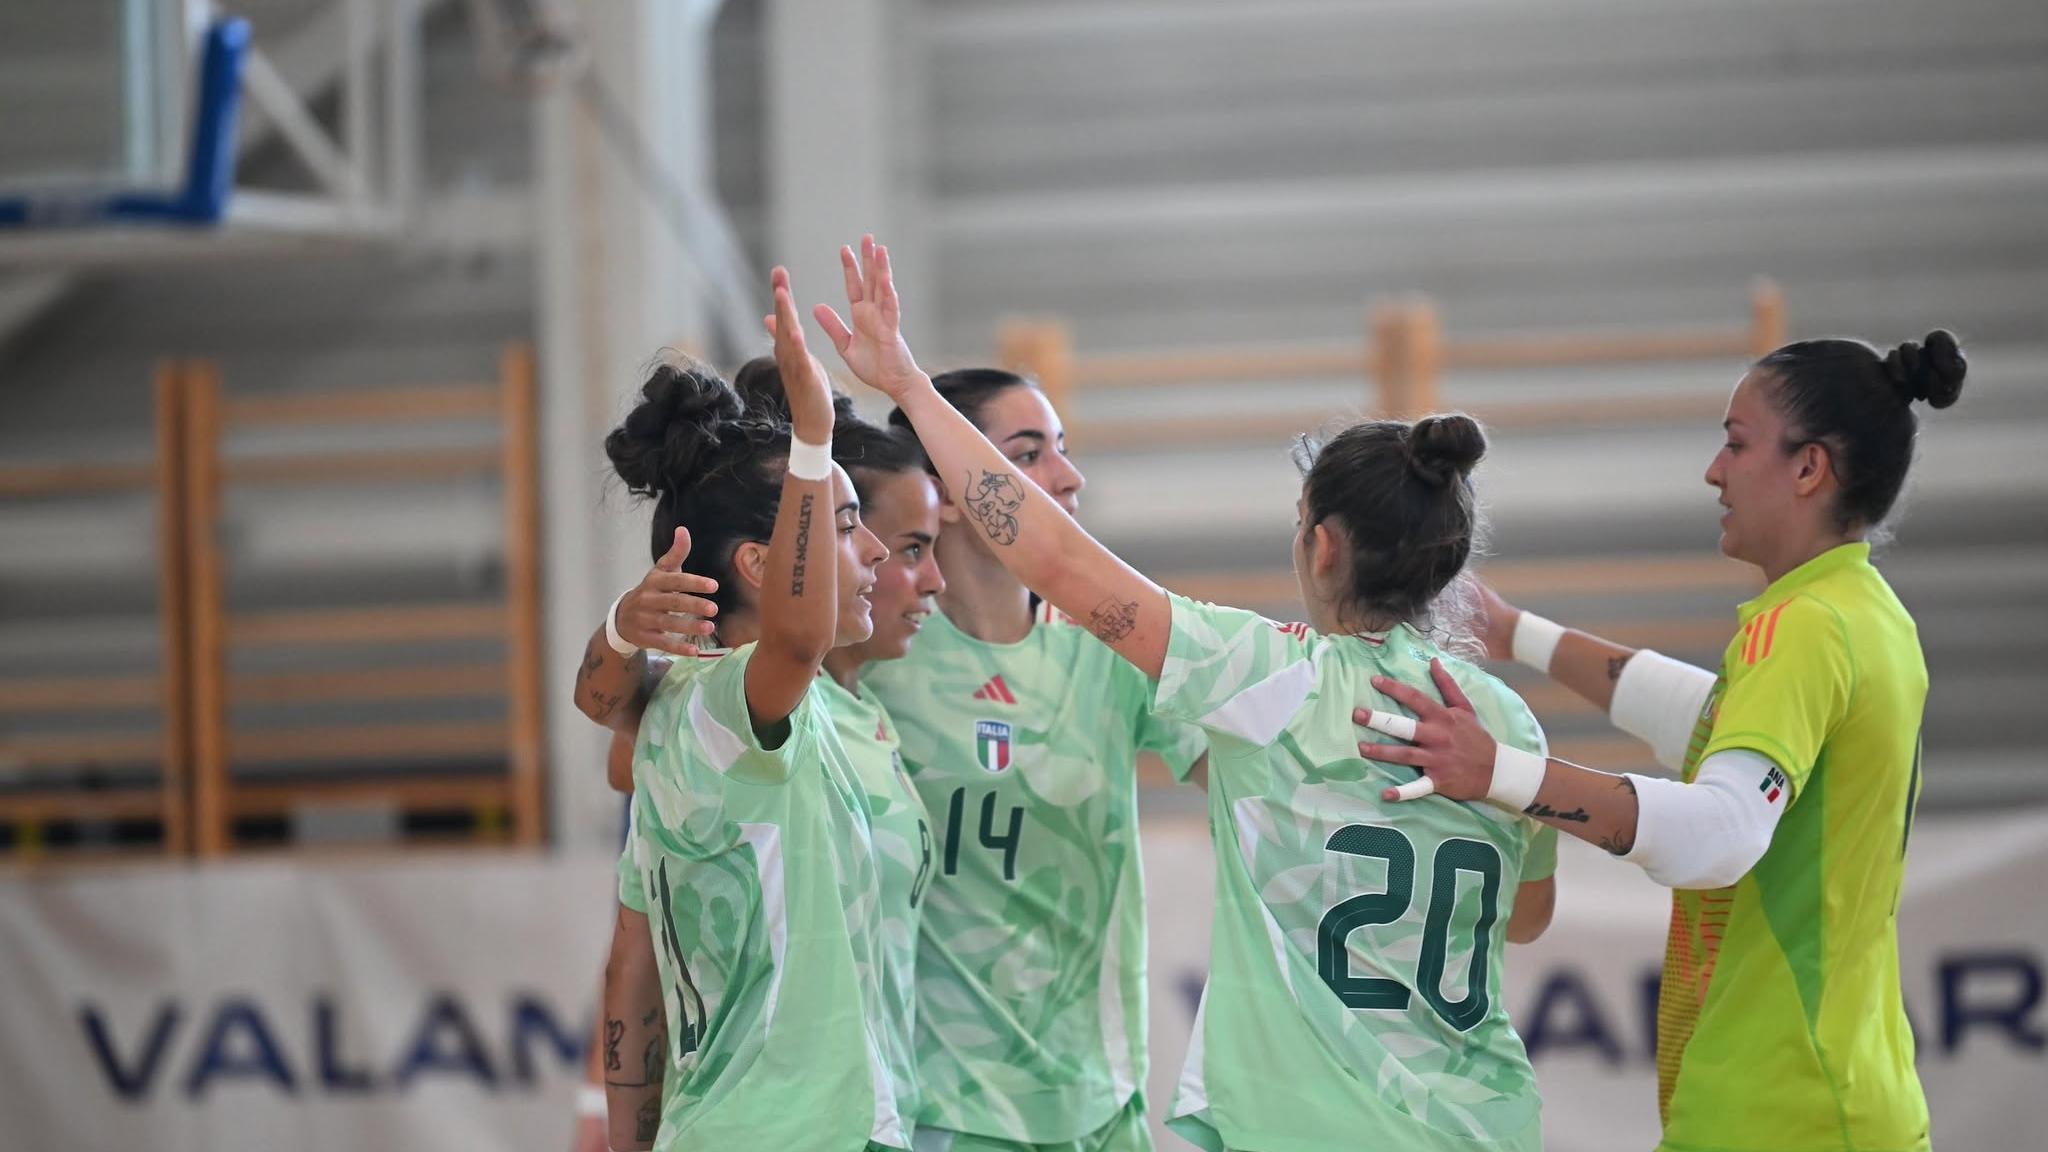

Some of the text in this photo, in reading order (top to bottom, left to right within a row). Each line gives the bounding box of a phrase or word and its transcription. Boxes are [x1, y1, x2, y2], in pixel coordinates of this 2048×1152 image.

[976, 722, 1009, 737] ITALIA
[1767, 766, 1785, 789] ANA
[944, 786, 1024, 880] 14
[1317, 823, 1502, 1032] 20
